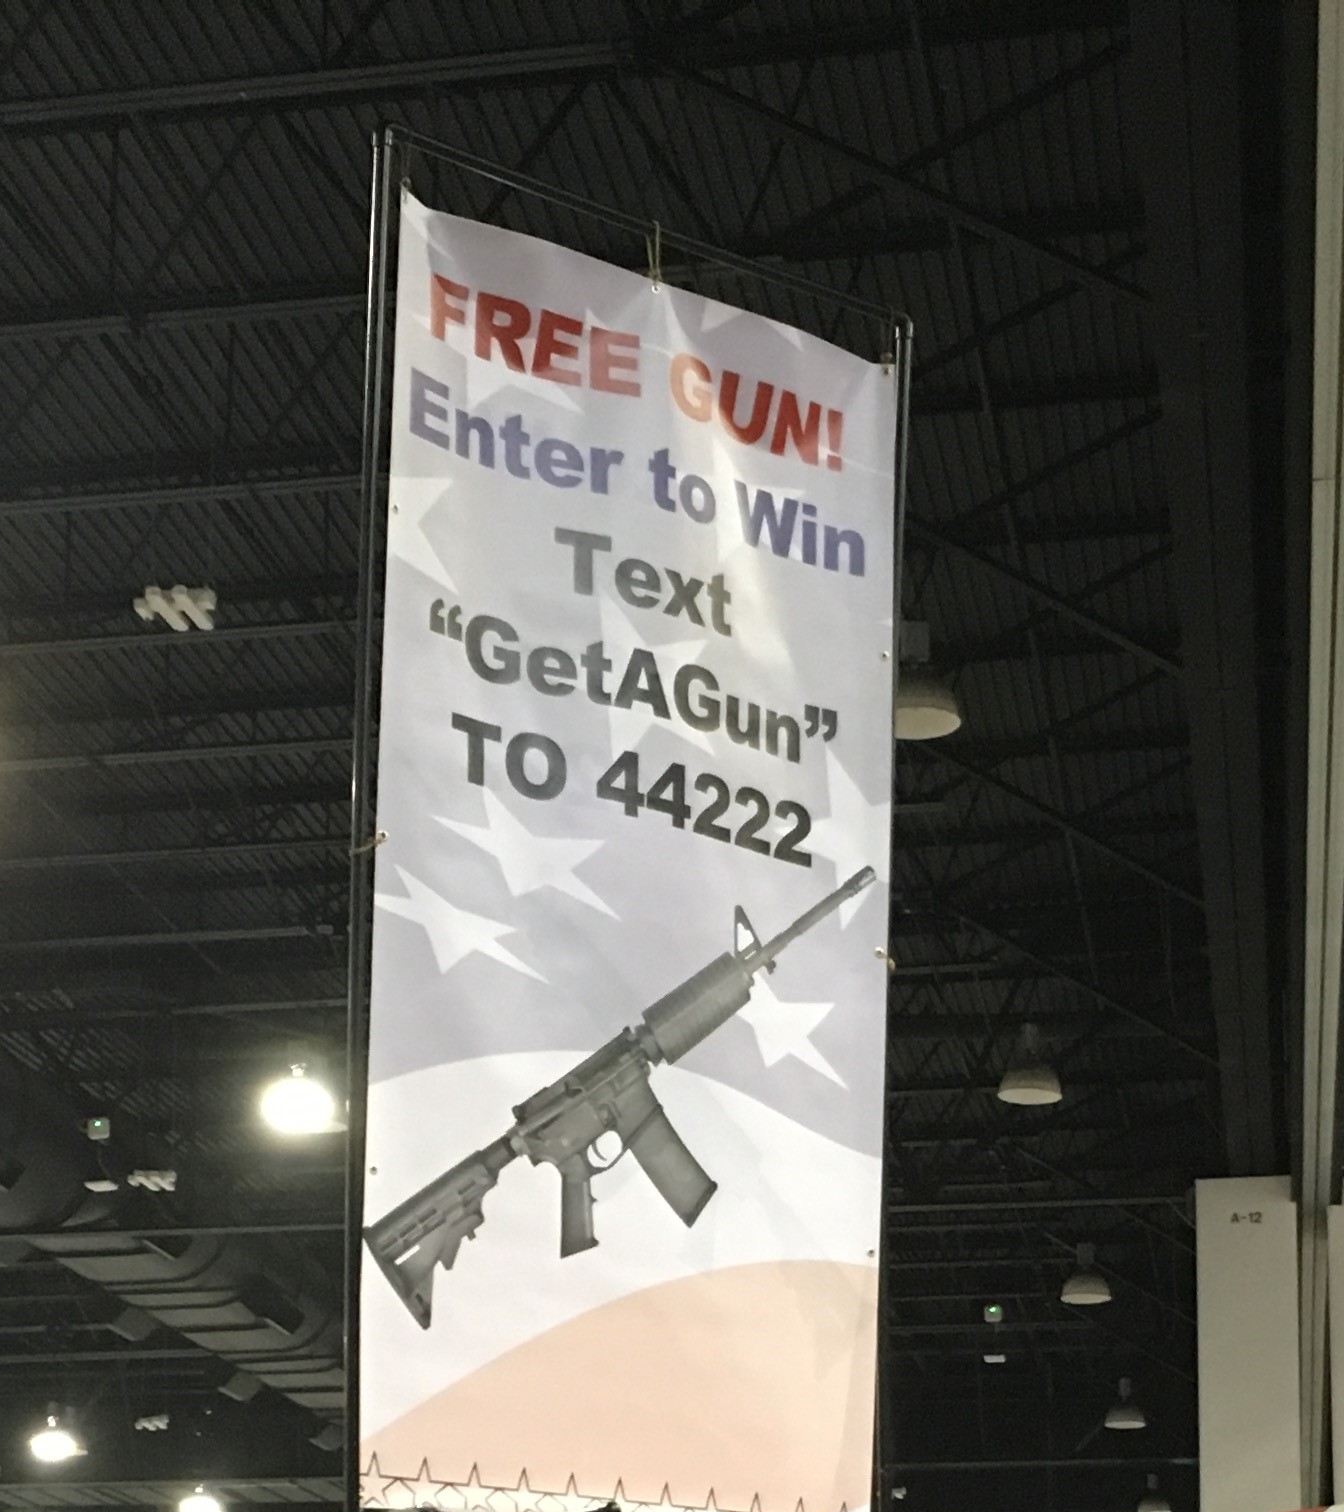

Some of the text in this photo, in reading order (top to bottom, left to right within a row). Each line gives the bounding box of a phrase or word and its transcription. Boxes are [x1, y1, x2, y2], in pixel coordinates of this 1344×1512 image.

[430, 273, 843, 471] FREE GUN!
[410, 366, 865, 577] Enter to Win
[554, 527, 732, 636] Text
[429, 598, 838, 763] “GetAGun”
[451, 712, 812, 868] TO 44222
[1230, 1212, 1262, 1223] A-12
